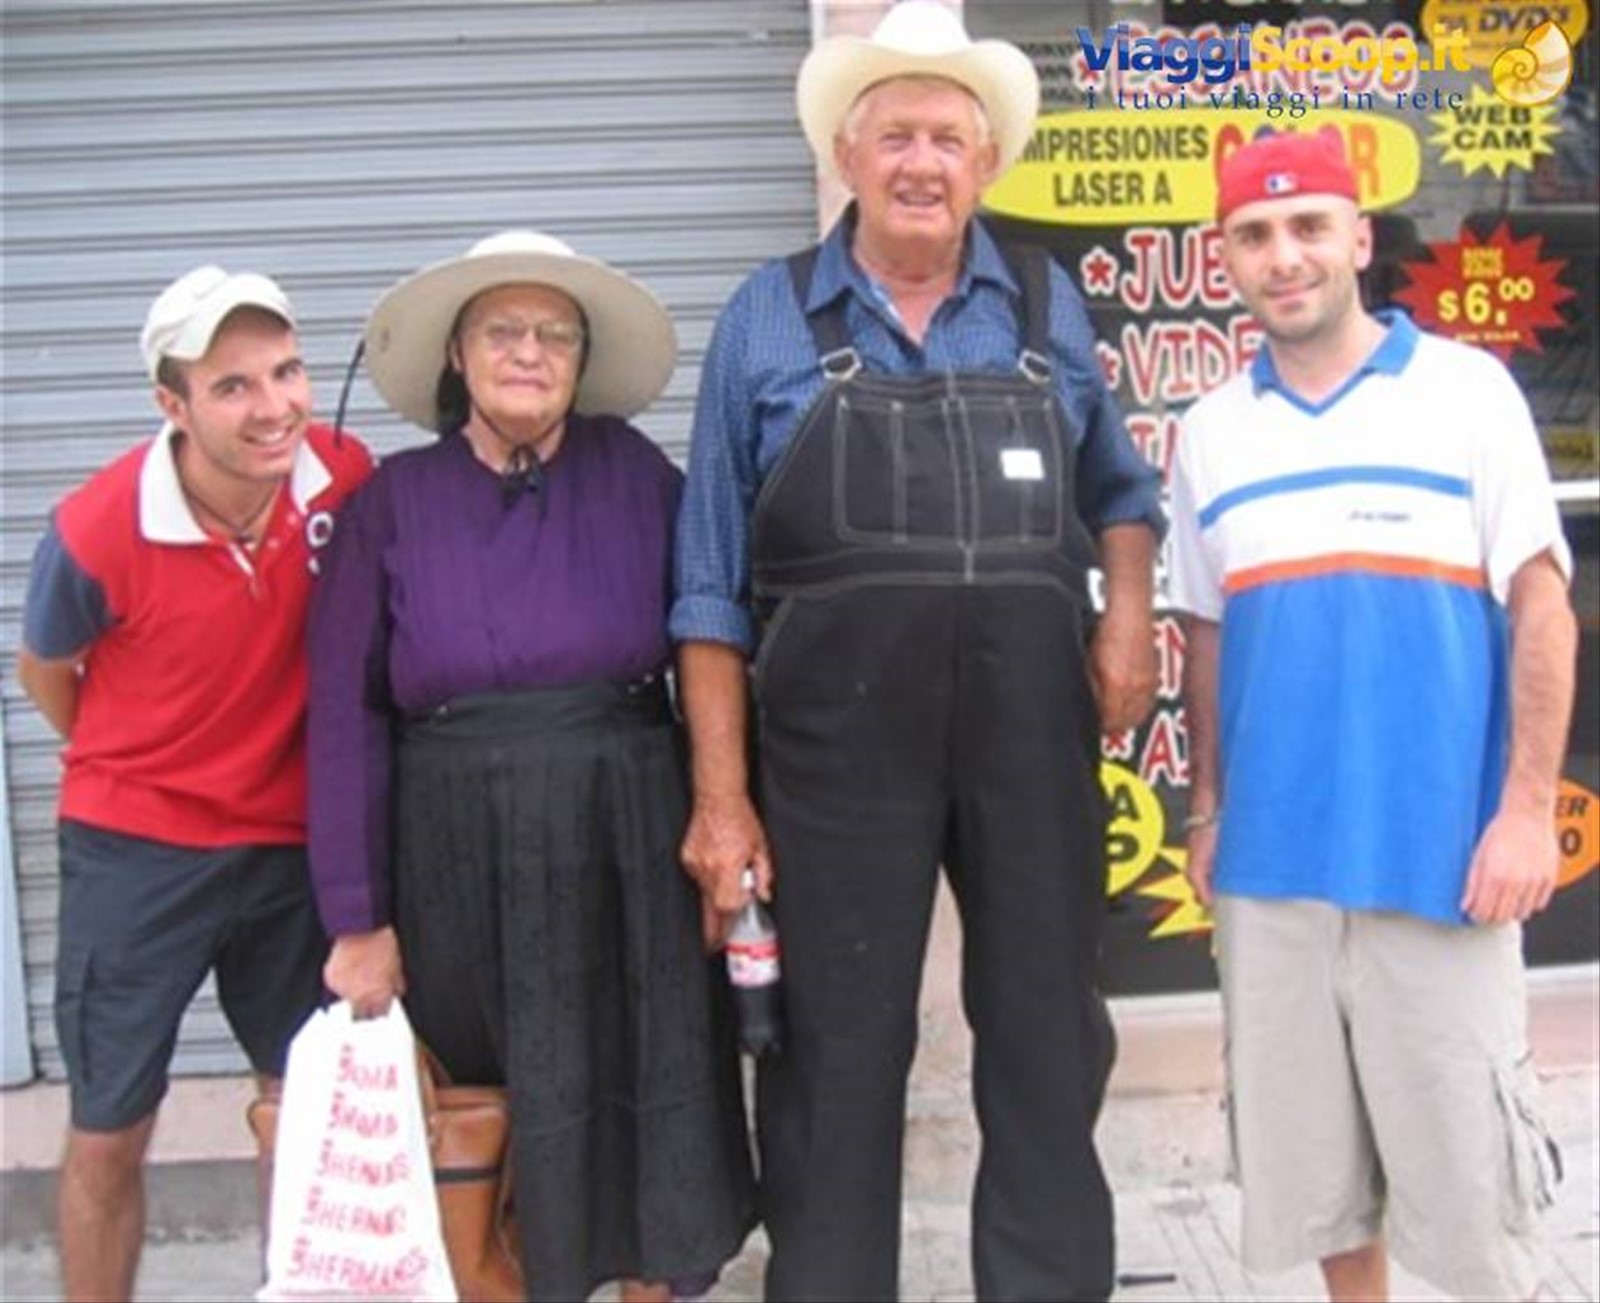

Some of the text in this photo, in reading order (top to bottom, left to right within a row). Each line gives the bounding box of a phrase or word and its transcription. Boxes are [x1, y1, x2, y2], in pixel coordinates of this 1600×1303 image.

[1454, 105, 1532, 125] WEB
[1018, 124, 1210, 164] MPRESIONES
[1453, 129, 1533, 150] CAM
[1053, 170, 1173, 207] LASER A
